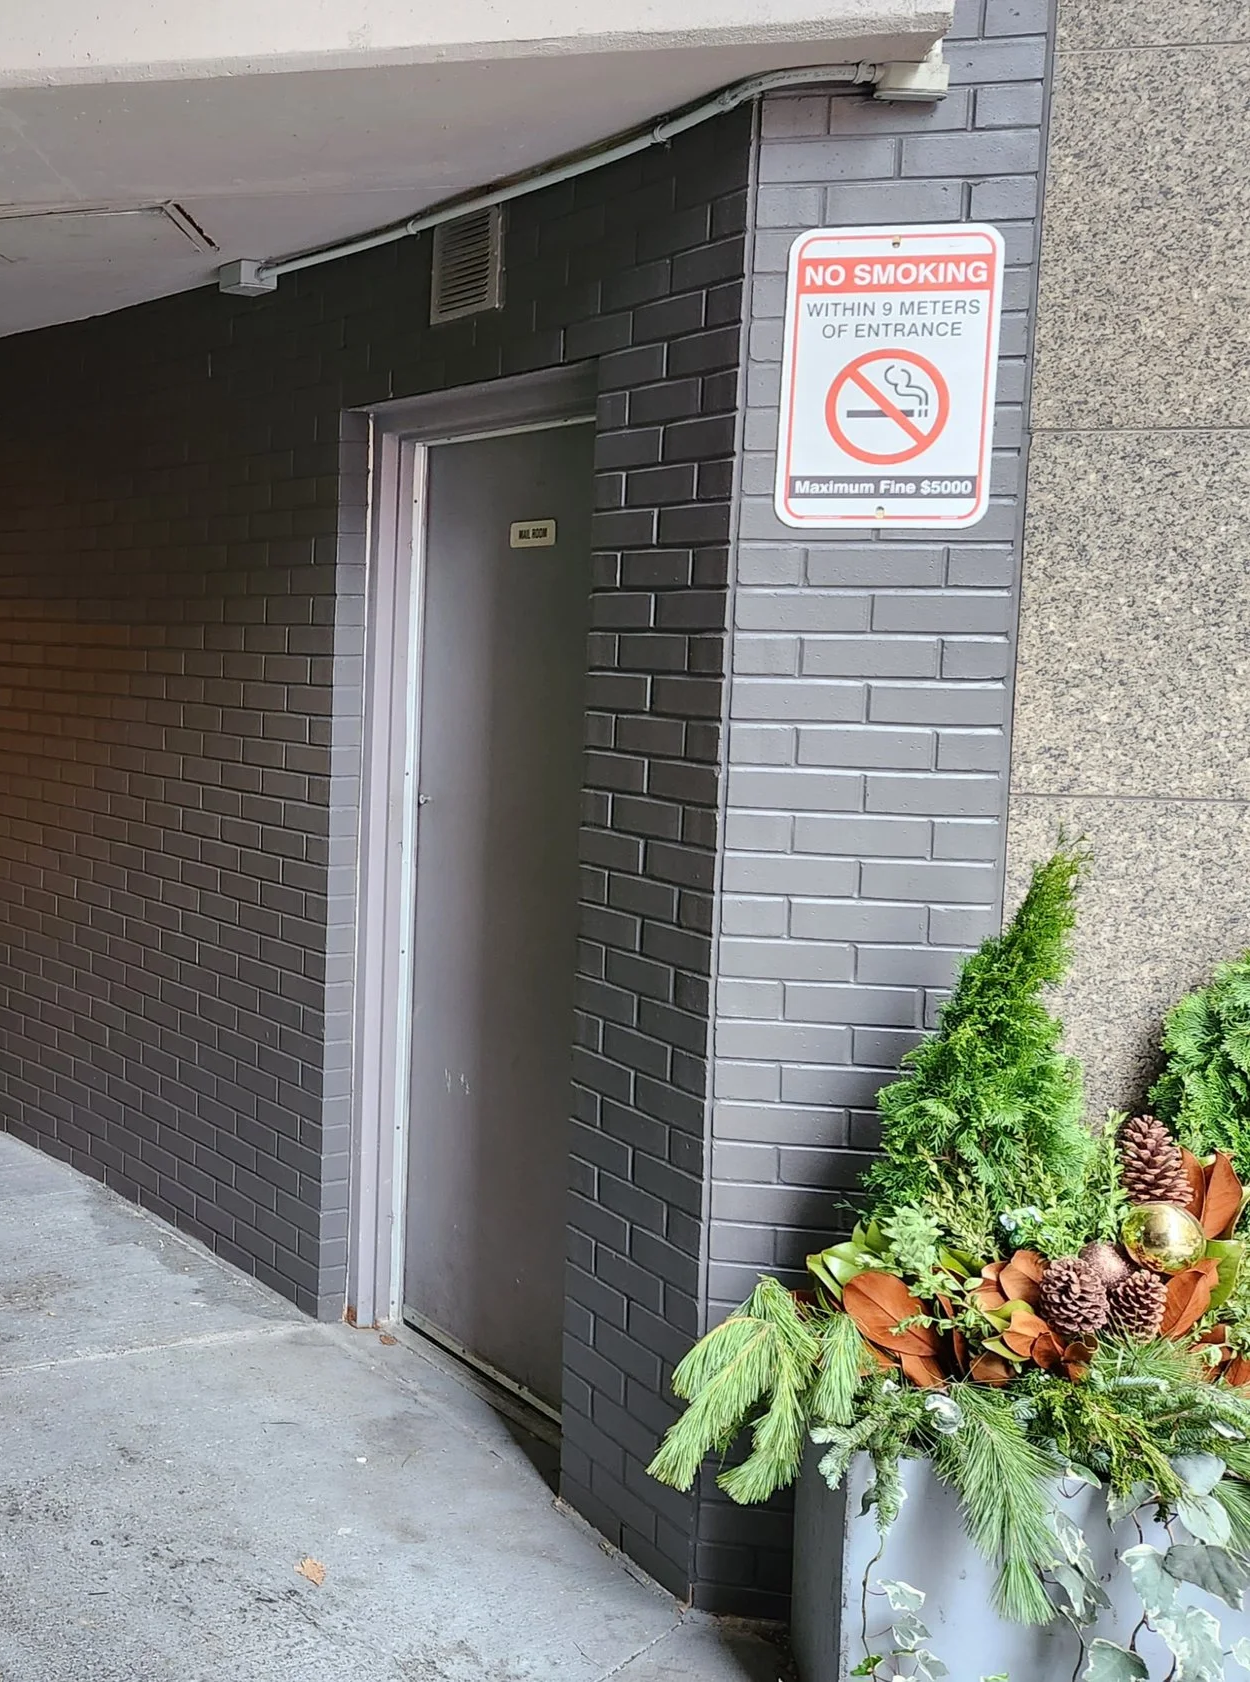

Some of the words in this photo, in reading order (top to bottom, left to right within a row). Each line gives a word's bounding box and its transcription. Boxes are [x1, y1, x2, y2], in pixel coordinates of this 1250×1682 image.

[805, 265, 846, 286] NO
[853, 261, 988, 285] SMOKING
[806, 302, 876, 317] WITHIN
[882, 302, 893, 316] 9
[899, 299, 981, 316] METERS
[822, 323, 849, 339] OF
[854, 321, 962, 338] ENTRANCE
[795, 480, 875, 494] Maximum
[879, 480, 916, 494] Fine
[920, 480, 972, 495] $5000
[519, 529, 531, 539] MAIL
[532, 527, 547, 538] ROOM
